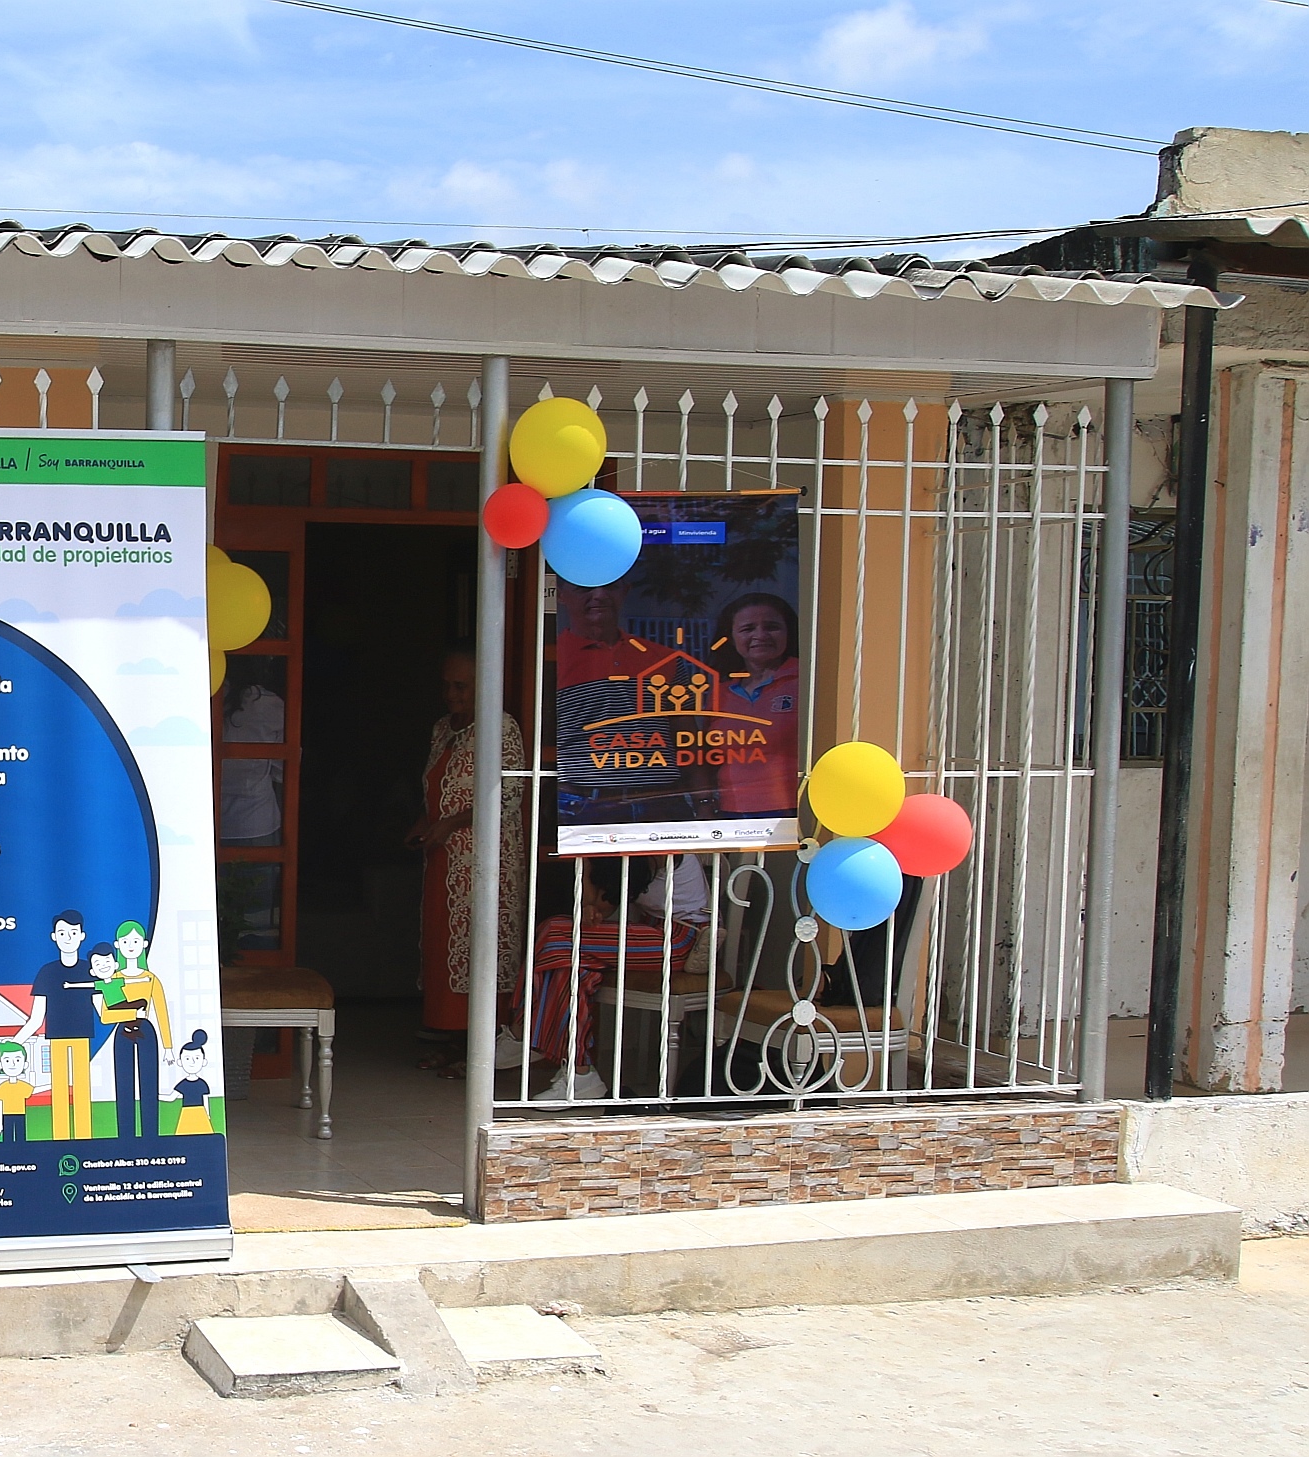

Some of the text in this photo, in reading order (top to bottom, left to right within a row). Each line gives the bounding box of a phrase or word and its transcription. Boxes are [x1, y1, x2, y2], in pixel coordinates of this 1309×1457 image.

[38, 453, 145, 471] Soy BARRANQUILLA
[33, 545, 57, 563] de
[63, 547, 173, 567] propietarios
[588, 728, 767, 749] CASA DIGNA
[590, 747, 767, 769] VIDA DIGNA
[82, 1160, 113, 1169] Chatbot
[135, 1158, 149, 1166] 310
[150, 1157, 166, 1165] 442
[83, 1183, 121, 1193] Ventanilla
[133, 1181, 145, 1190] del
[146, 1180, 174, 1189] edificio
[175, 1178, 203, 1188] central
[83, 1189, 193, 1202] de la Alcaldía de Barranquilla
